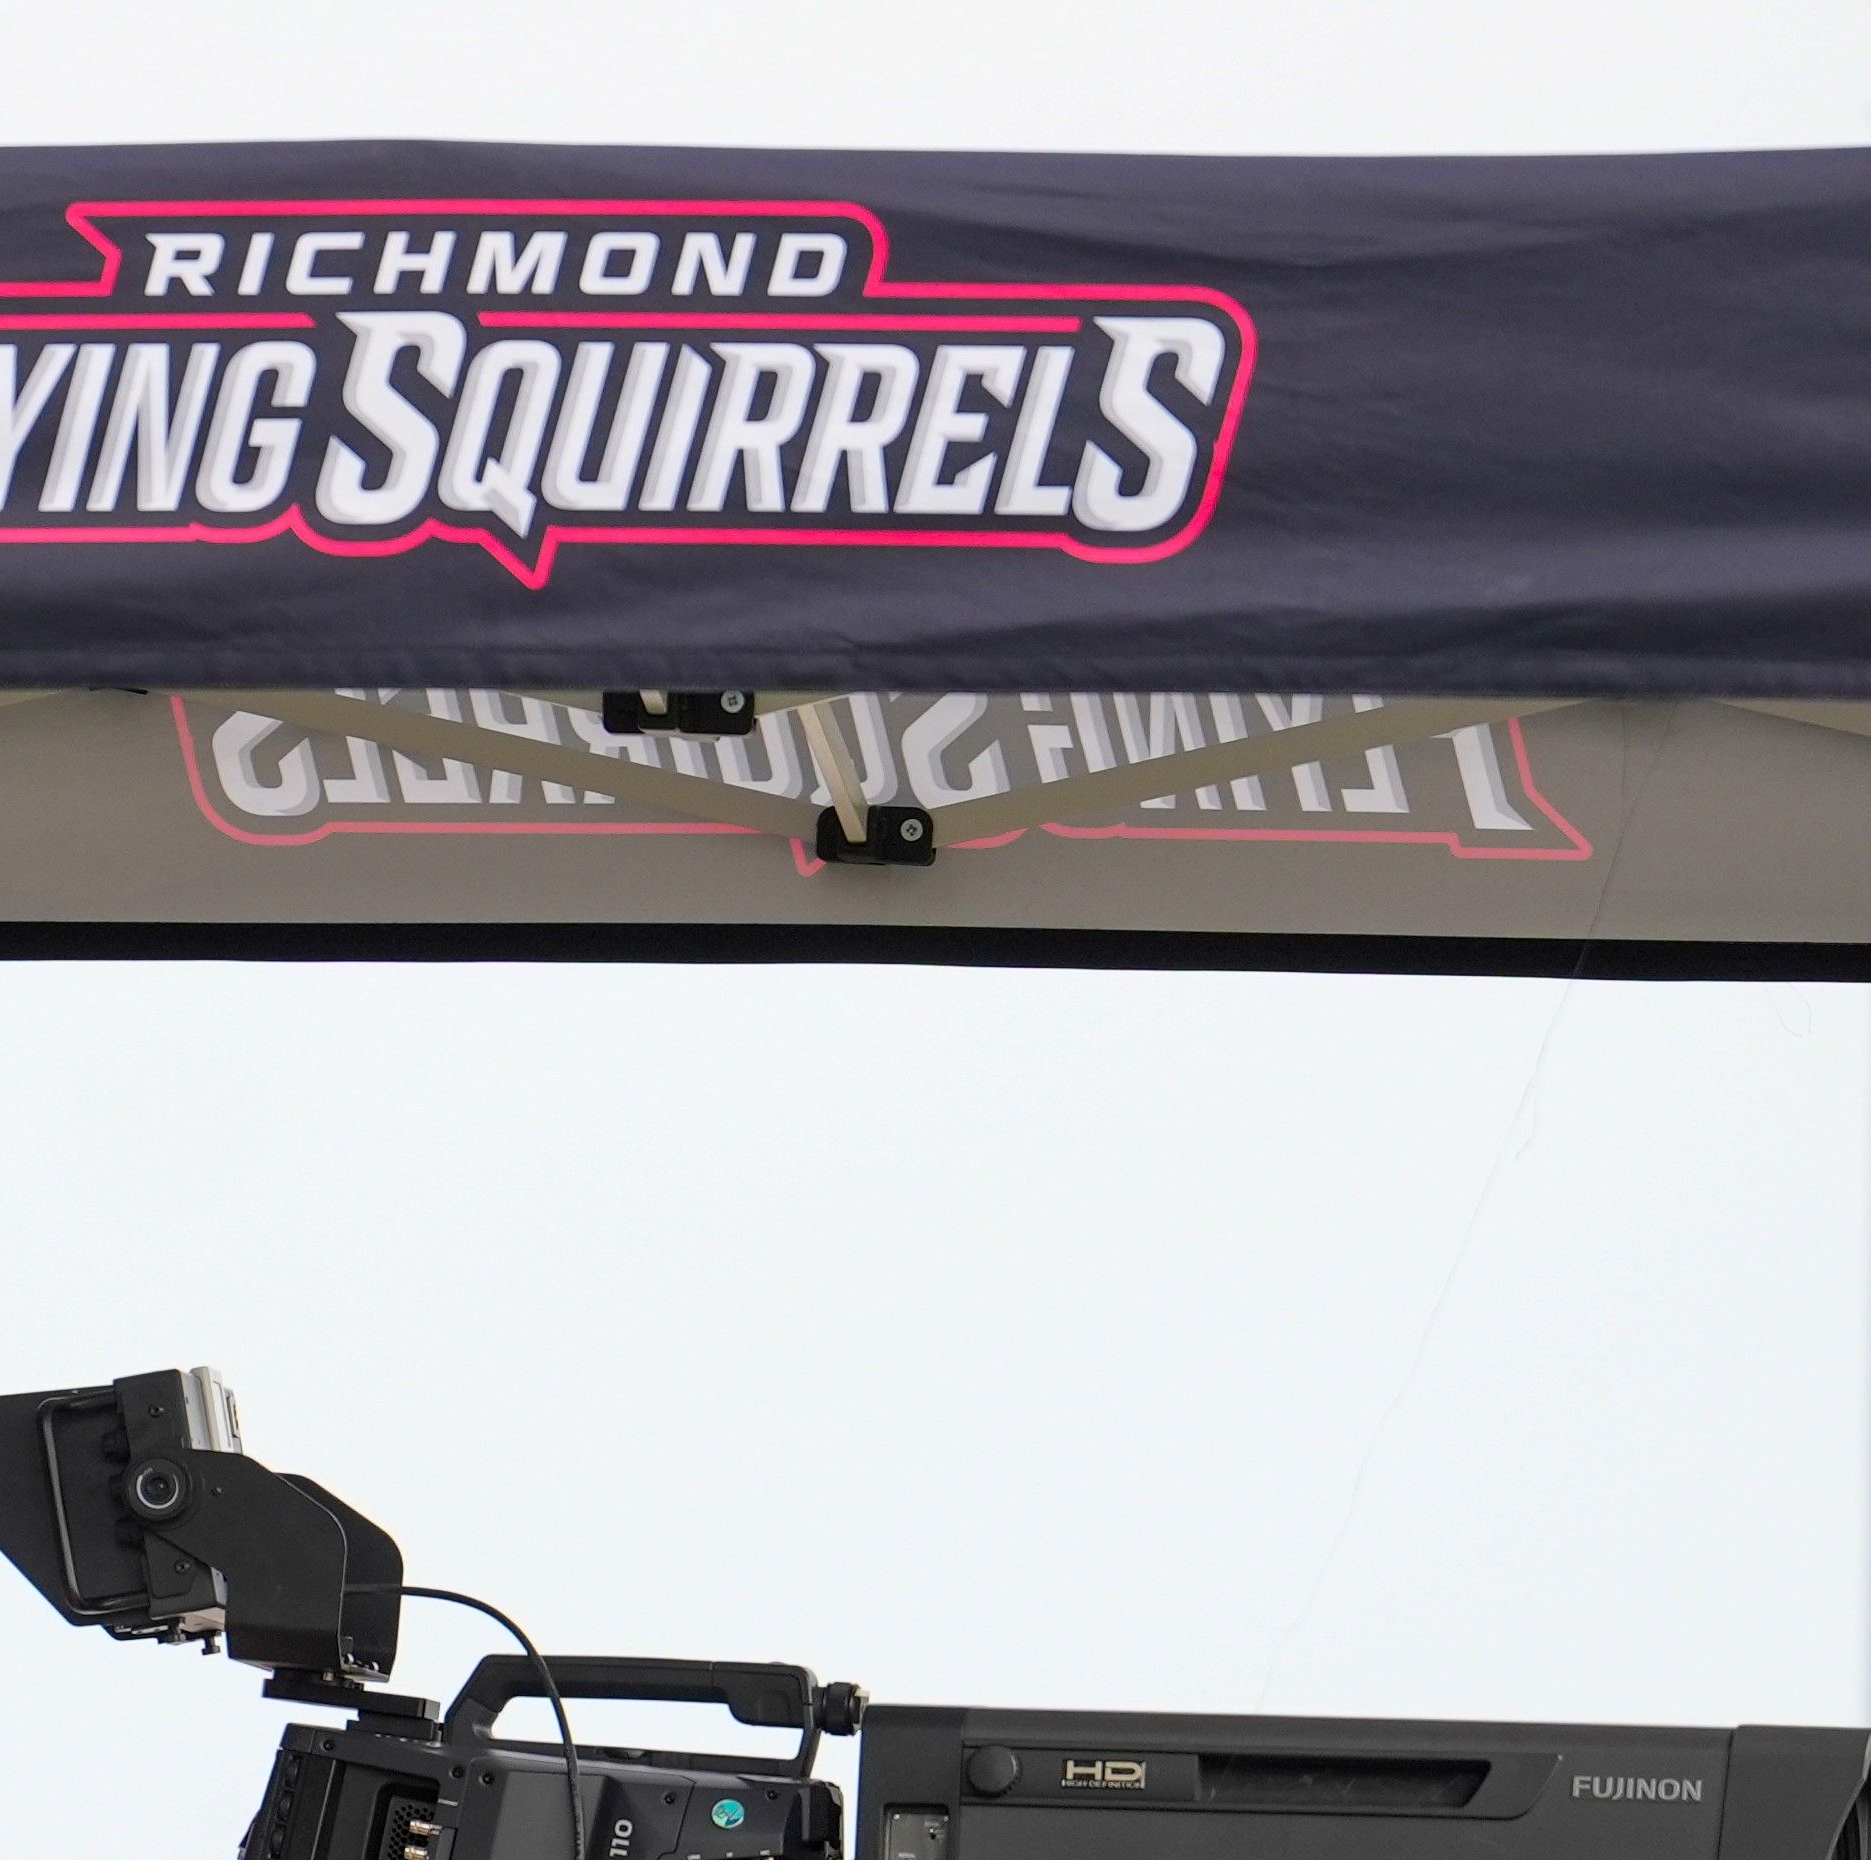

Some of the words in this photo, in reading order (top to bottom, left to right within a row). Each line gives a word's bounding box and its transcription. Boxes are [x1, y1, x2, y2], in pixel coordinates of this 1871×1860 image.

[145, 229, 850, 300] RICHMOND
[314, 310, 1225, 540] SQUIRRELS
[1065, 1760, 1142, 1780] HD
[1572, 1775, 1703, 1801] FUJINON
[609, 1818, 633, 1858] 110
